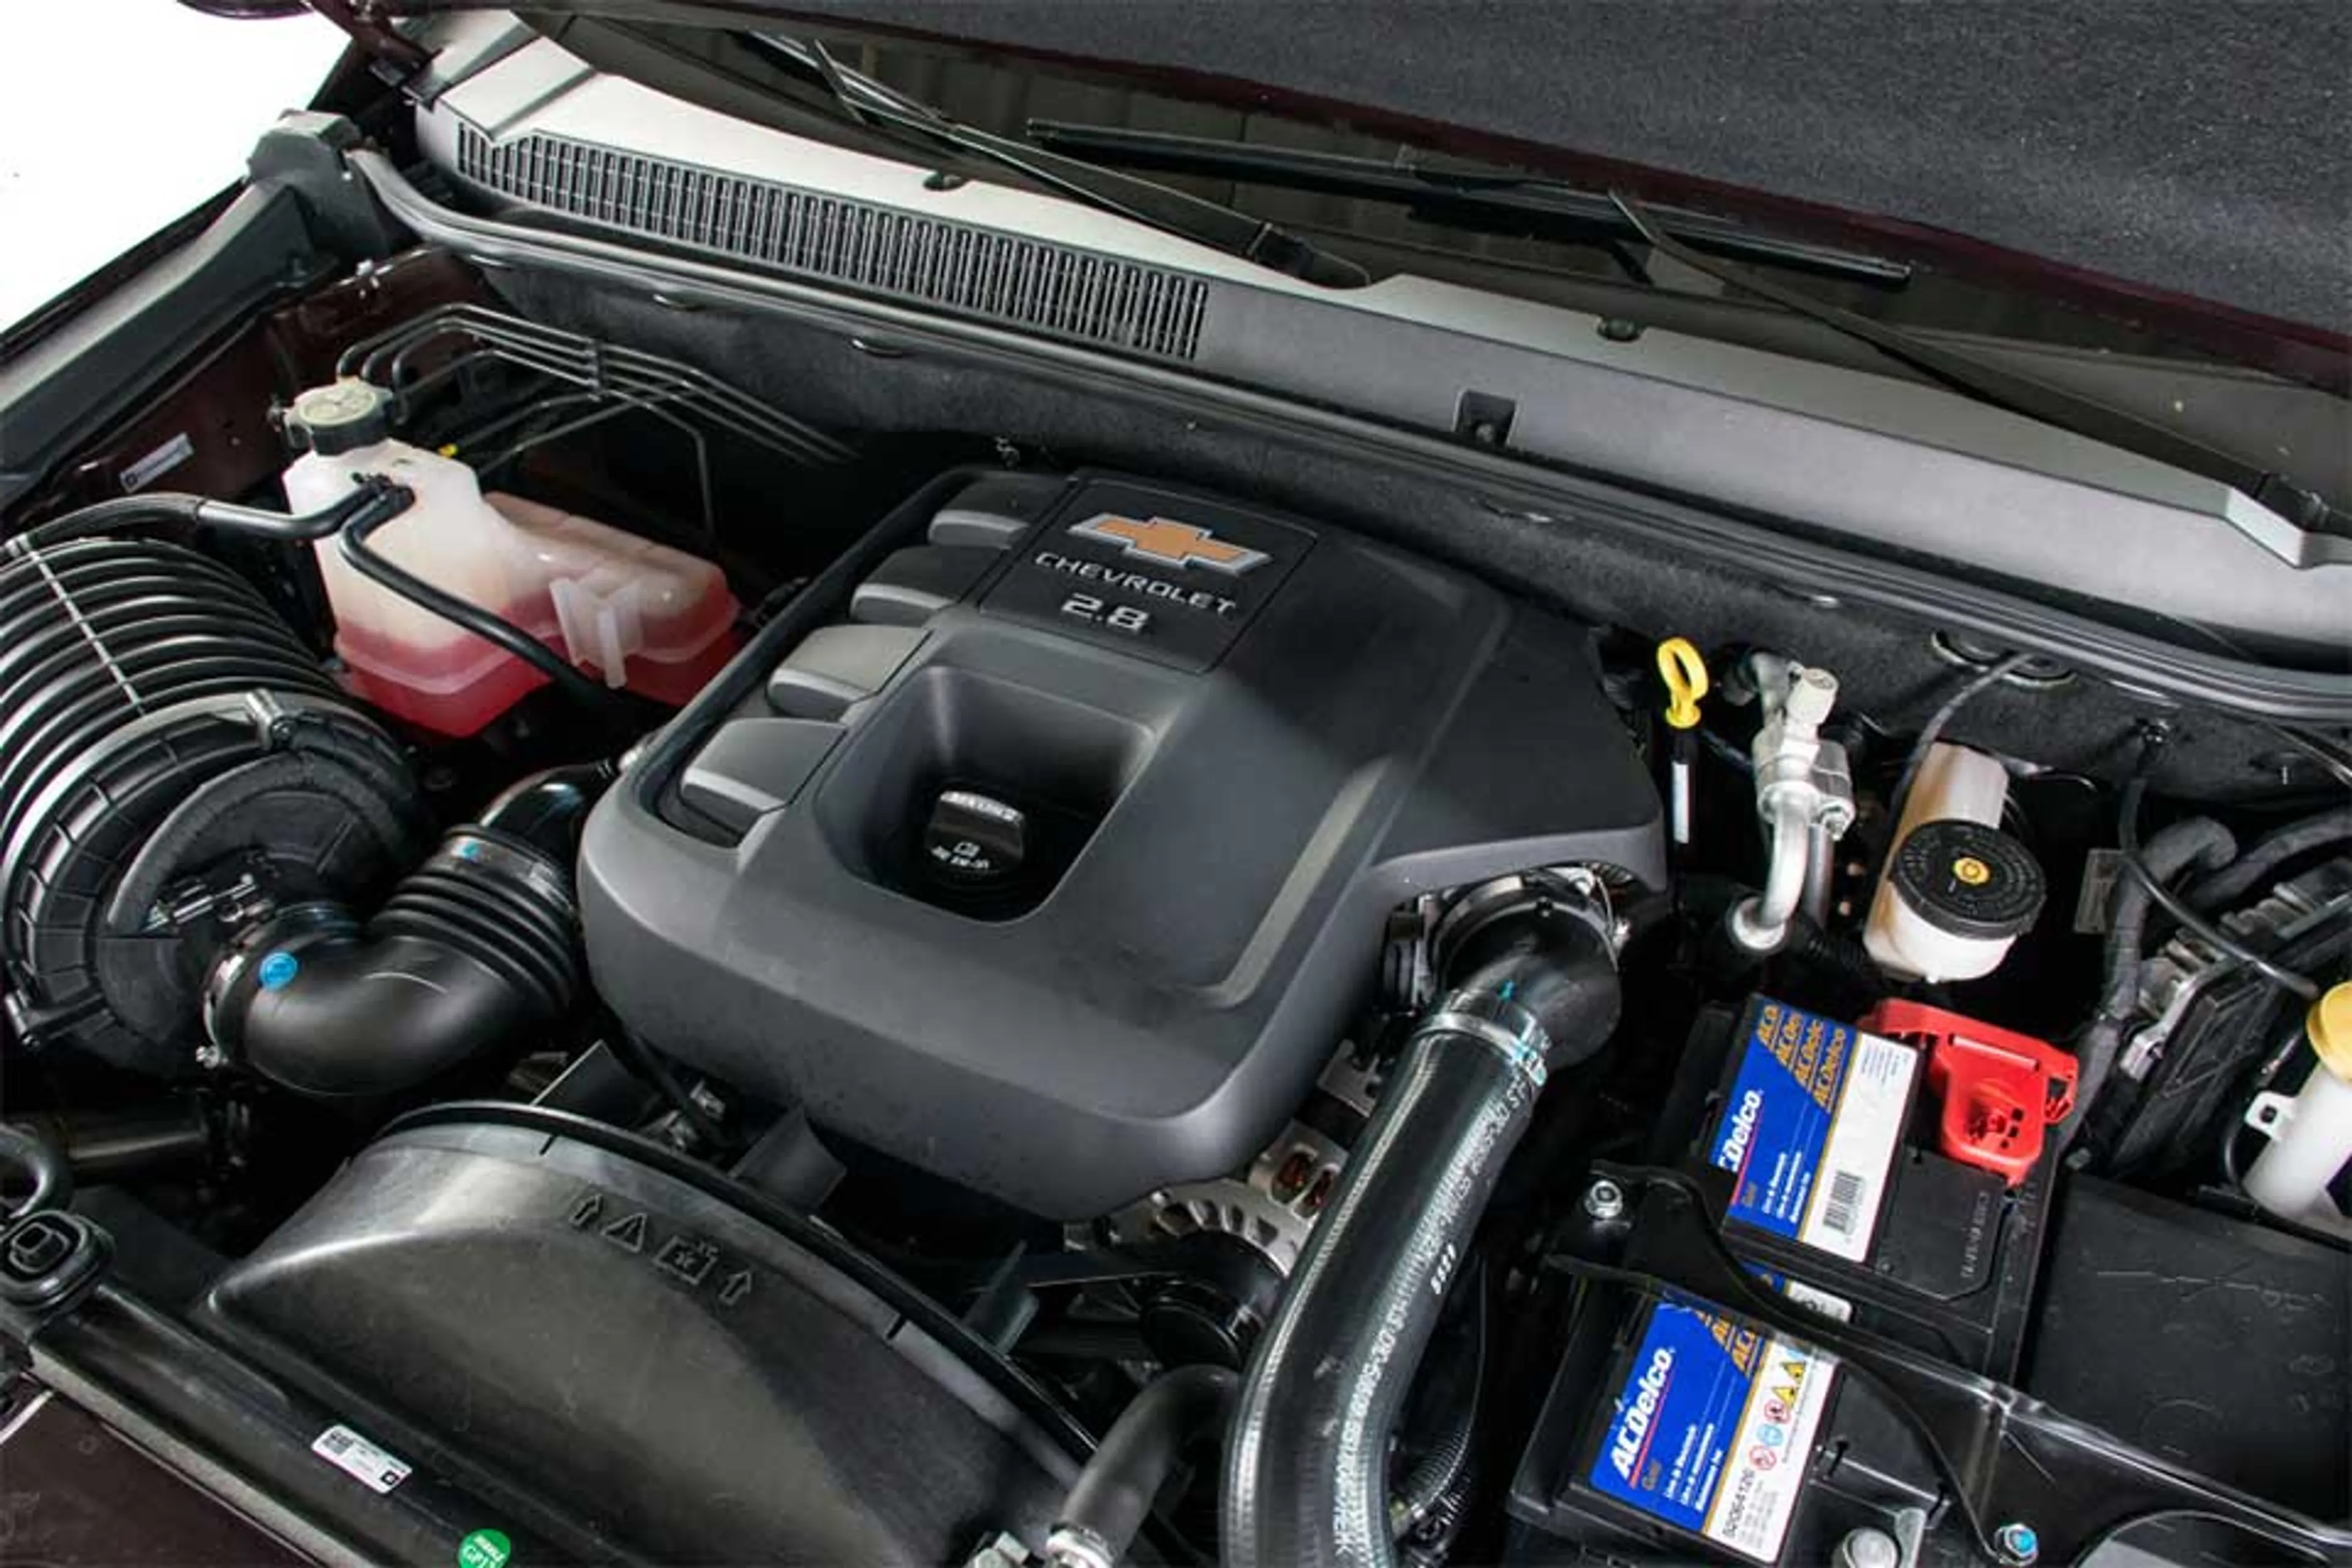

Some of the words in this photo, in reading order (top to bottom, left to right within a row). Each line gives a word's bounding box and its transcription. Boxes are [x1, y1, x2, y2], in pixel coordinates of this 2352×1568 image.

[1035, 552, 1236, 615] CHEVROLET
[1061, 592, 1149, 632] 2.8
[1610, 1348, 1673, 1480] ACDelco
